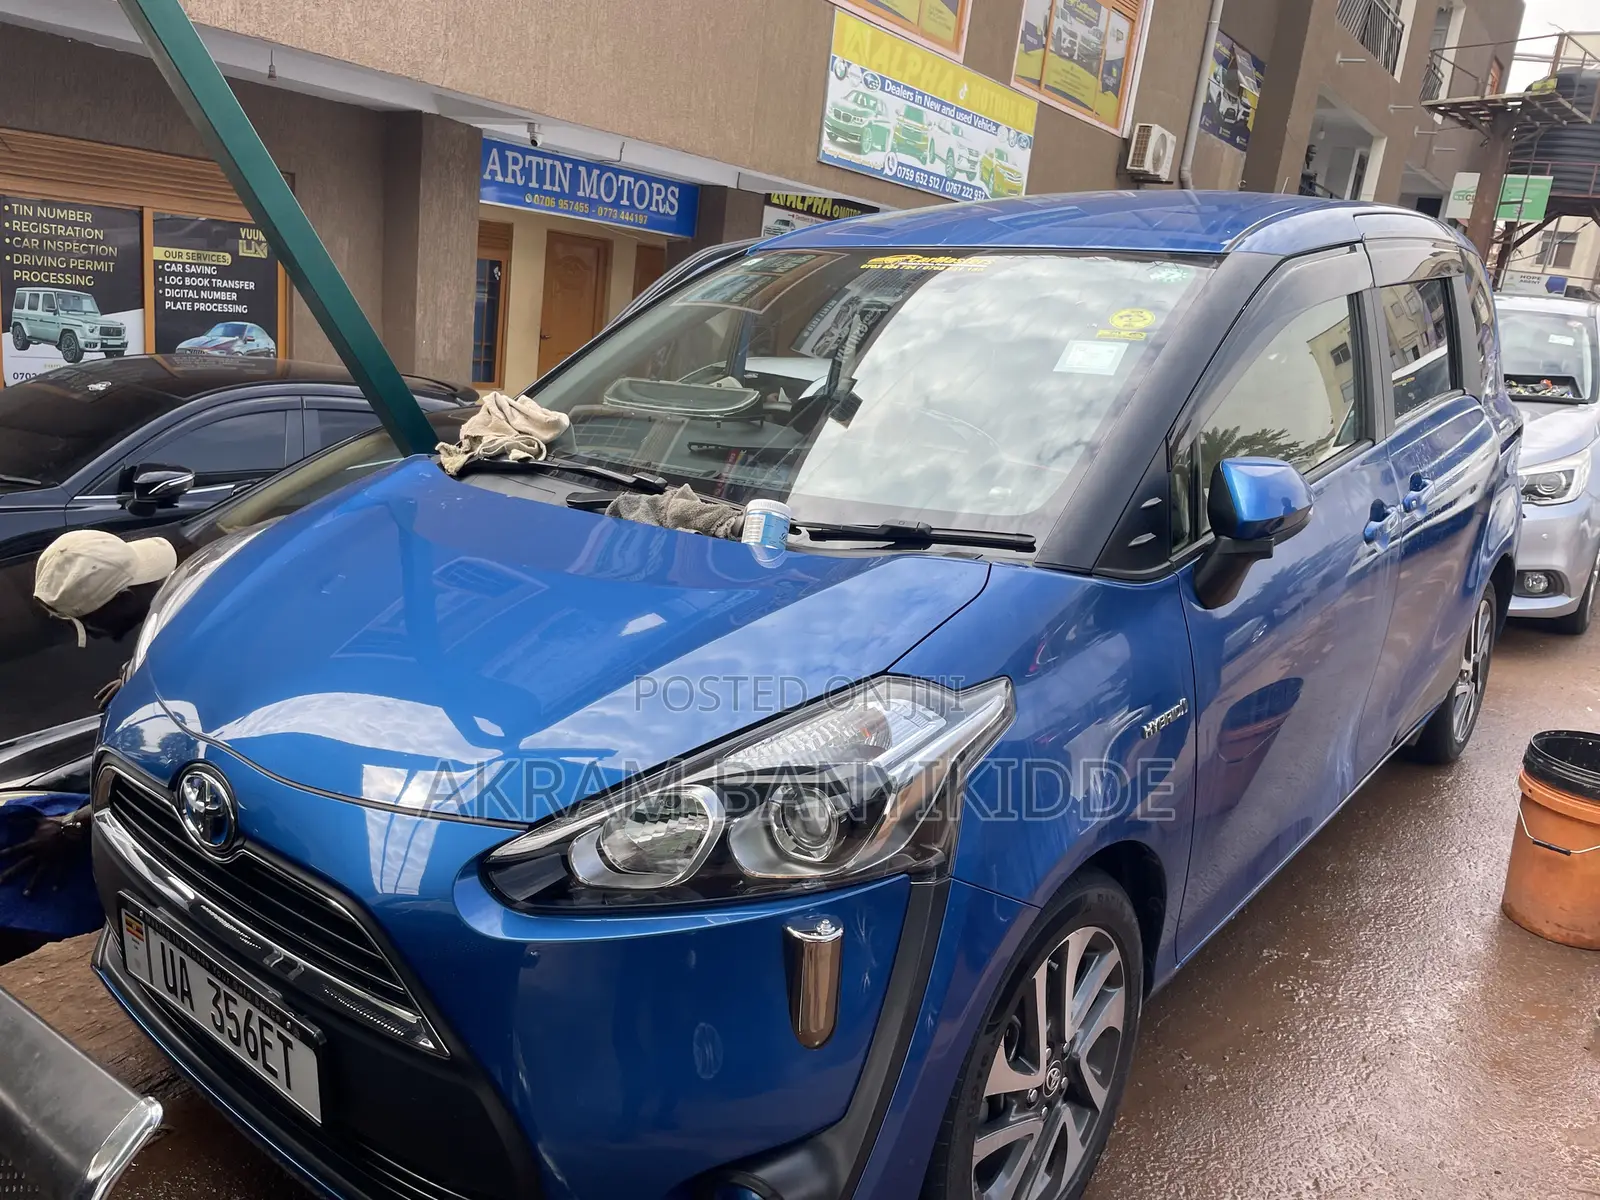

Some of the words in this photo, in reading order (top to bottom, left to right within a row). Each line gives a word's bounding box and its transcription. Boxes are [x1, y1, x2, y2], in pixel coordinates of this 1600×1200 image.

[884, 79, 914, 101] Dealers
[915, 91, 923, 103] in
[924, 95, 941, 112] New
[941, 104, 955, 117] and
[956, 107, 972, 124] used
[482, 147, 573, 194] ARTIN
[577, 165, 680, 216] MOTORS
[896, 166, 914, 182] 0759
[915, 172, 928, 186] 632
[928, 176, 940, 189] 512
[945, 181, 961, 195] 0767
[961, 186, 973, 199] 222
[12, 203, 33, 216] TIN
[37, 206, 93, 223] NUMBER
[533, 194, 556, 208] 0706
[558, 199, 589, 214] 957455
[597, 206, 618, 219] 0773
[619, 210, 648, 225] 444197
[12, 220, 104, 240] REGISTRATION
[12, 237, 39, 250] CAR
[43, 240, 118, 257] INSPECTION
[164, 250, 184, 260] OUR
[13, 254, 66, 269] DRIVING
[70, 258, 115, 272] PERMIT
[164, 262, 183, 273] CAR
[185, 264, 218, 275] SAVING
[13, 269, 94, 286] PROCESSING
[164, 275, 183, 285] LOG
[185, 277, 210, 287] BOOK
[212, 279, 255, 290] TRANSFER
[164, 288, 199, 299] DIGITAL
[200, 290, 237, 301] NUMBER
[165, 300, 192, 311] PLATE
[194, 302, 248, 313] PROCESSING
[160, 940, 195, 1013] UA
[206, 976, 294, 1091] 356ET
